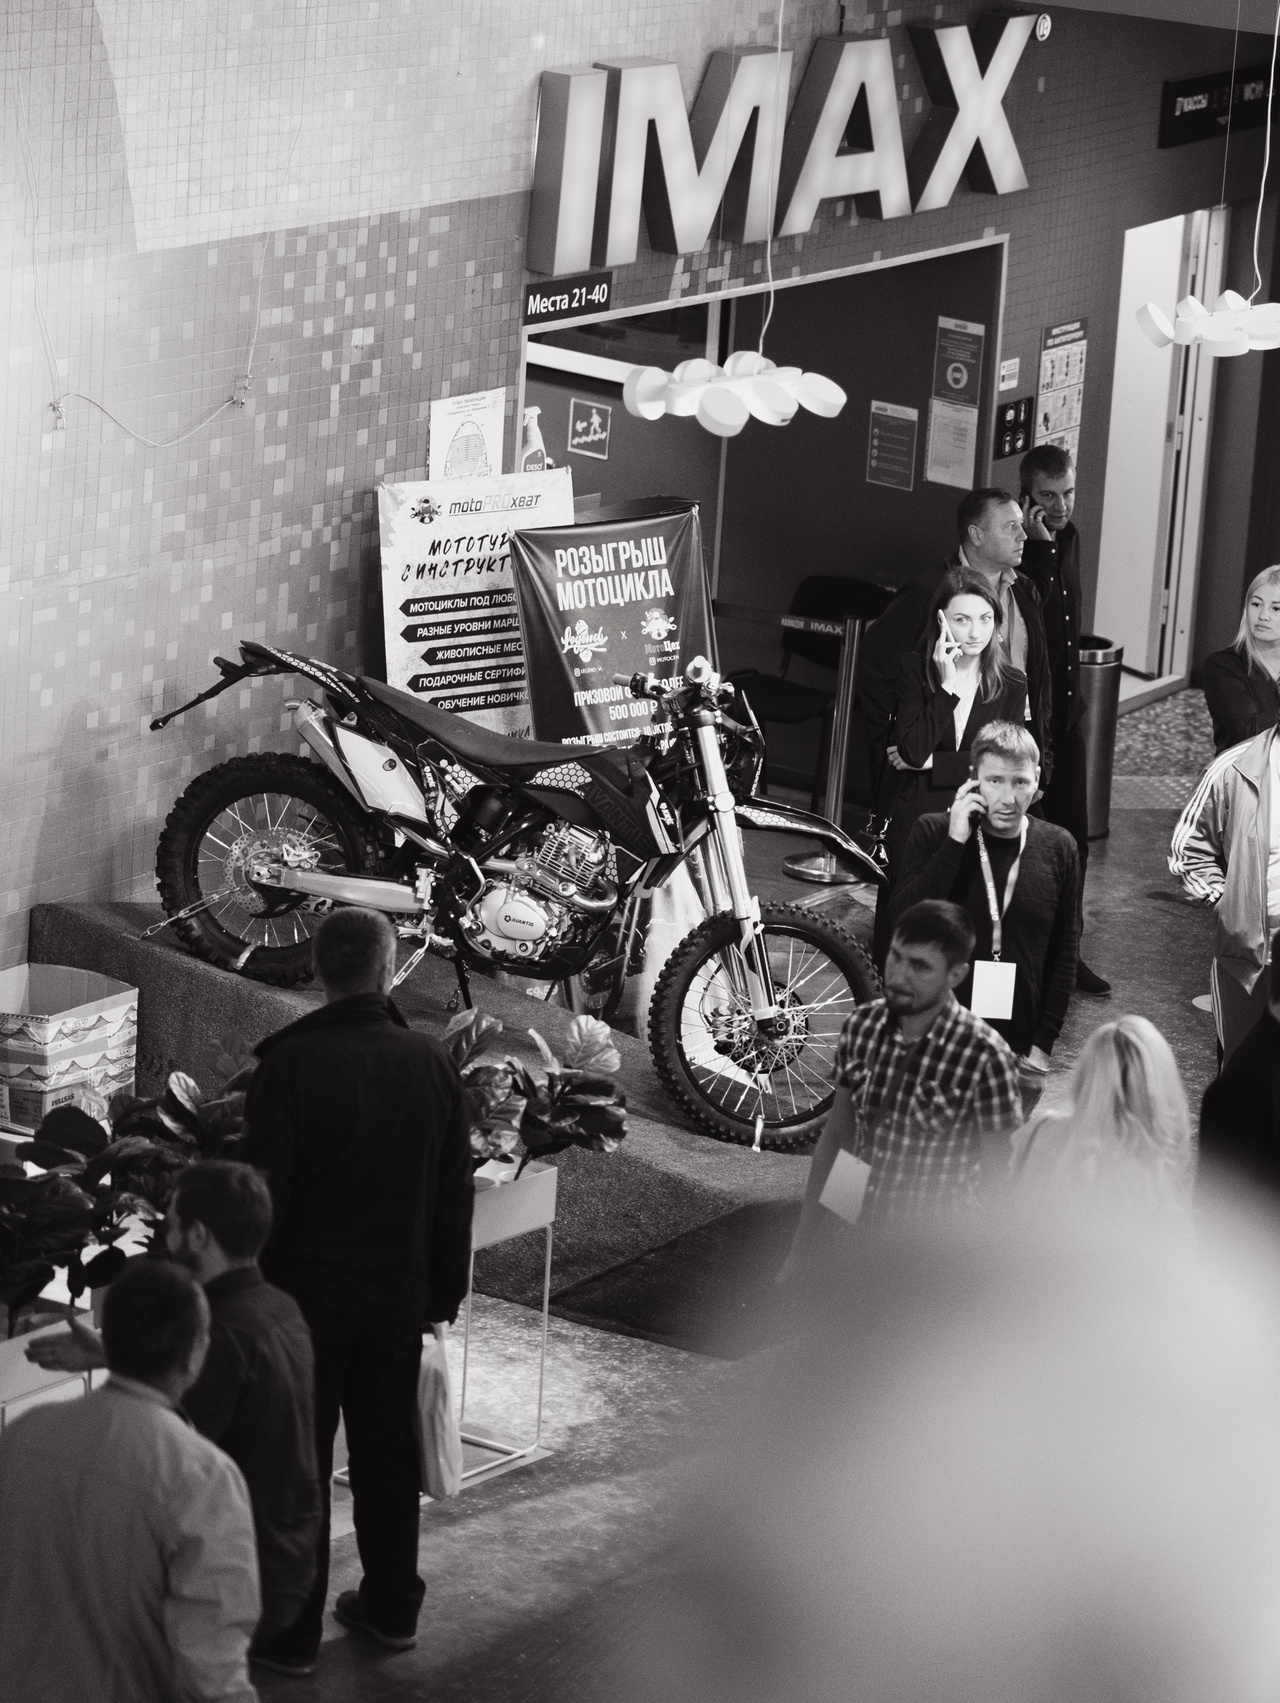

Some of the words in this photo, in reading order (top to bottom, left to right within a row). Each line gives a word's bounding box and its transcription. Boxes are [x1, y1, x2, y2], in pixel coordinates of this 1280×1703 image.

[538, 14, 1038, 276] IMAX
[527, 286, 569, 316] Места
[571, 282, 608, 309] 21-40
[554, 536, 667, 578] РОЗЫГРЫШ
[555, 568, 676, 611] МОТОЦИКЛА
[409, 598, 469, 614] МОТОЦИКЛЫ
[470, 595, 490, 608] ПОД
[417, 624, 453, 638] РАЗНЫЕ
[453, 620, 492, 634] УРОВНИ
[810, 621, 844, 636] IMAX
[436, 643, 502, 661] ЖИВОПИСНЫЕ
[418, 671, 484, 688] ПОДАРОЧНЫЕ
[437, 695, 487, 710] ОБУЧЕНИЕ
[574, 685, 625, 708] ПРИЗОВОЙ
[608, 703, 630, 721] 500
[629, 701, 649, 718] 000
[511, 918, 535, 928] AVANTIS
